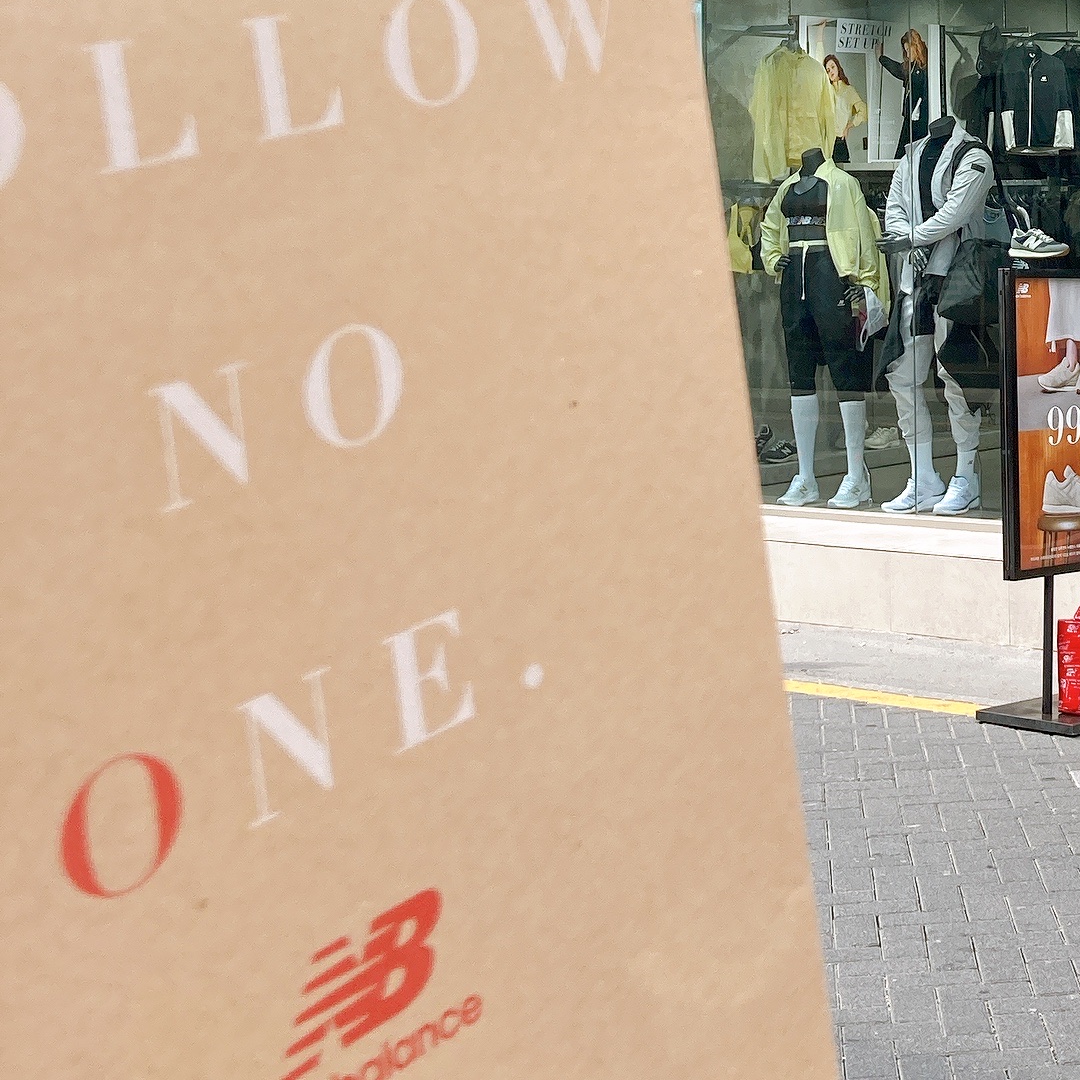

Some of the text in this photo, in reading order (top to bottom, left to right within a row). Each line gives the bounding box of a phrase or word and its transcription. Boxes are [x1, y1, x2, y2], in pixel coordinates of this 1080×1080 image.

[838, 36, 879, 50] SET UP
[840, 23, 892, 37] STRETCH
[146, 323, 405, 514] NO
[59, 608, 546, 900] ONE.
[330, 993, 484, 1080] alance
